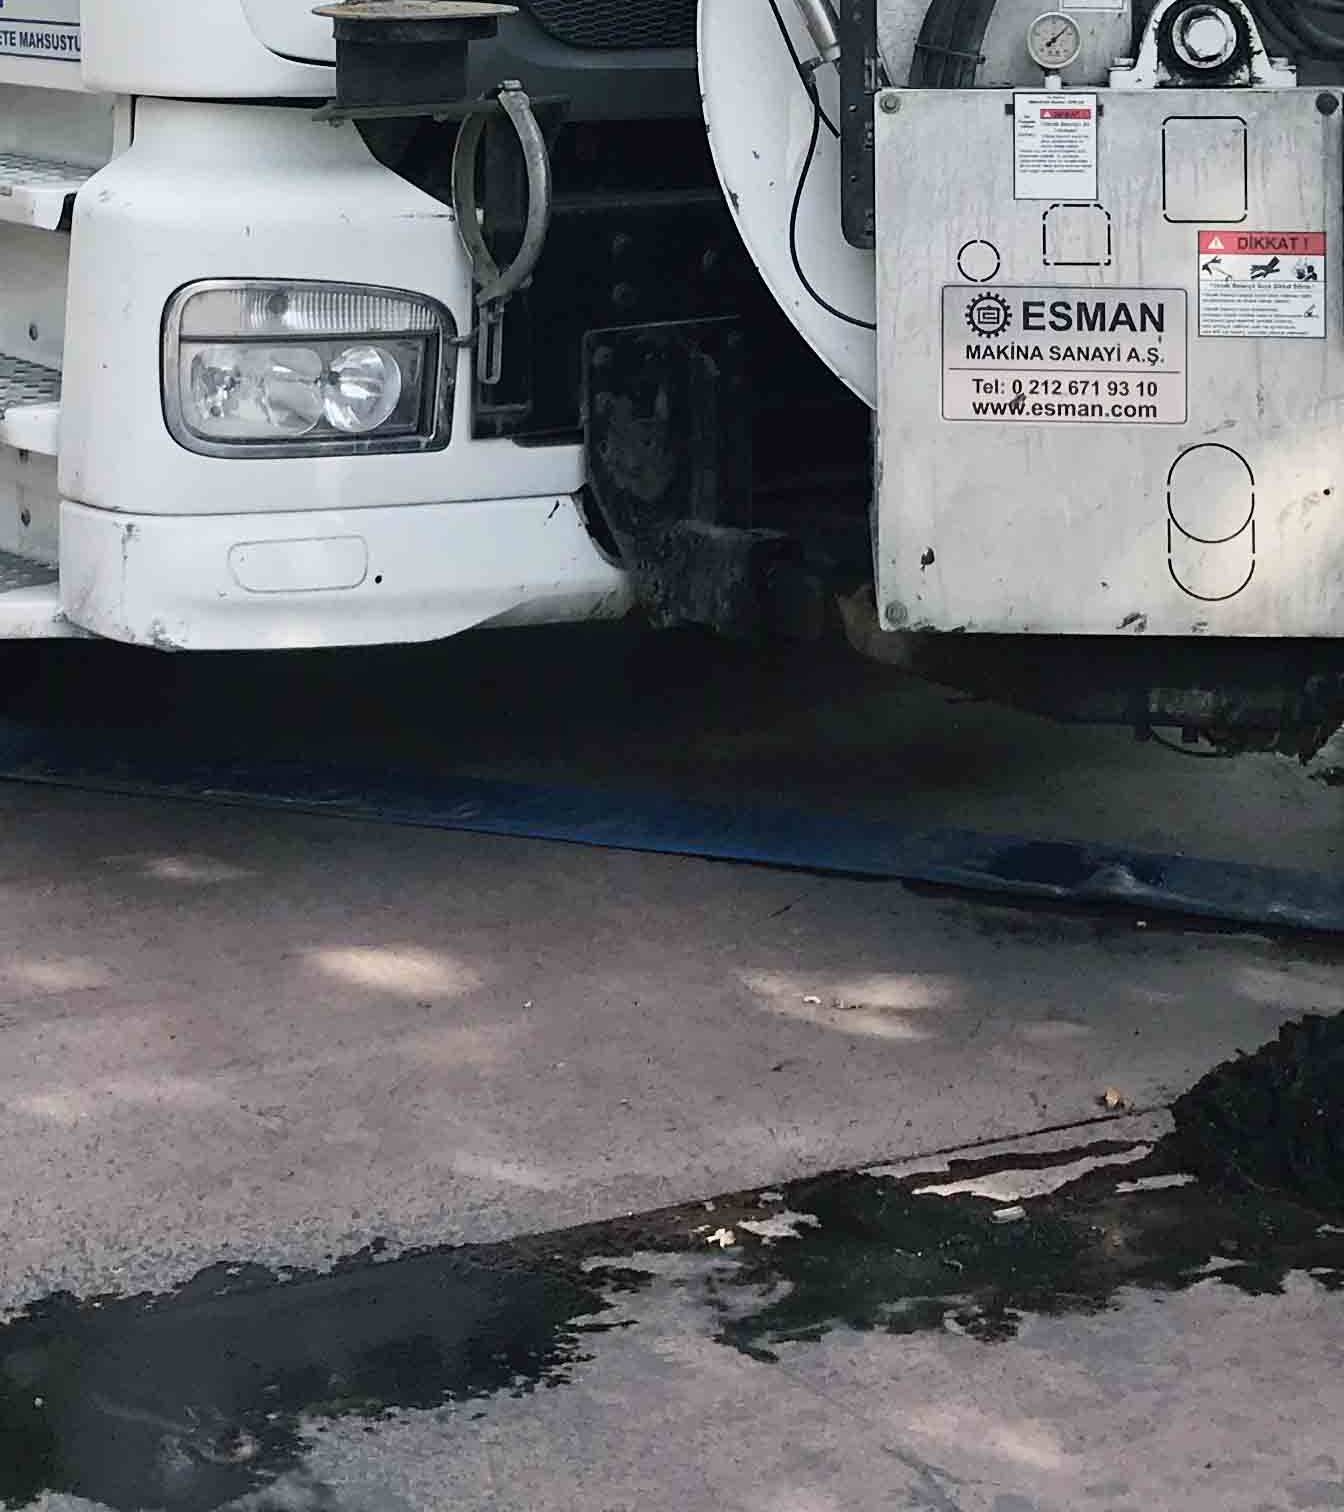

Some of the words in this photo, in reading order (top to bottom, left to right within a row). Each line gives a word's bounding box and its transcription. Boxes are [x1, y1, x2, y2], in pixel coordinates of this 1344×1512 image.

[19, 31, 81, 52] MAHSUSTU
[1237, 233, 1299, 251] DİKKAT
[1022, 300, 1165, 333] ESMAN
[965, 341, 1044, 362] MAKİNA
[1048, 344, 1122, 363] SANAYİ
[1127, 346, 1165, 367] A.Ş.
[972, 377, 1006, 396] Tel:
[1012, 379, 1024, 396] 0
[1029, 379, 1062, 396] 212
[1068, 380, 1100, 397] 671
[1107, 381, 1130, 397] 93
[1136, 381, 1158, 398] 10
[972, 400, 1158, 419] www.esman.com
